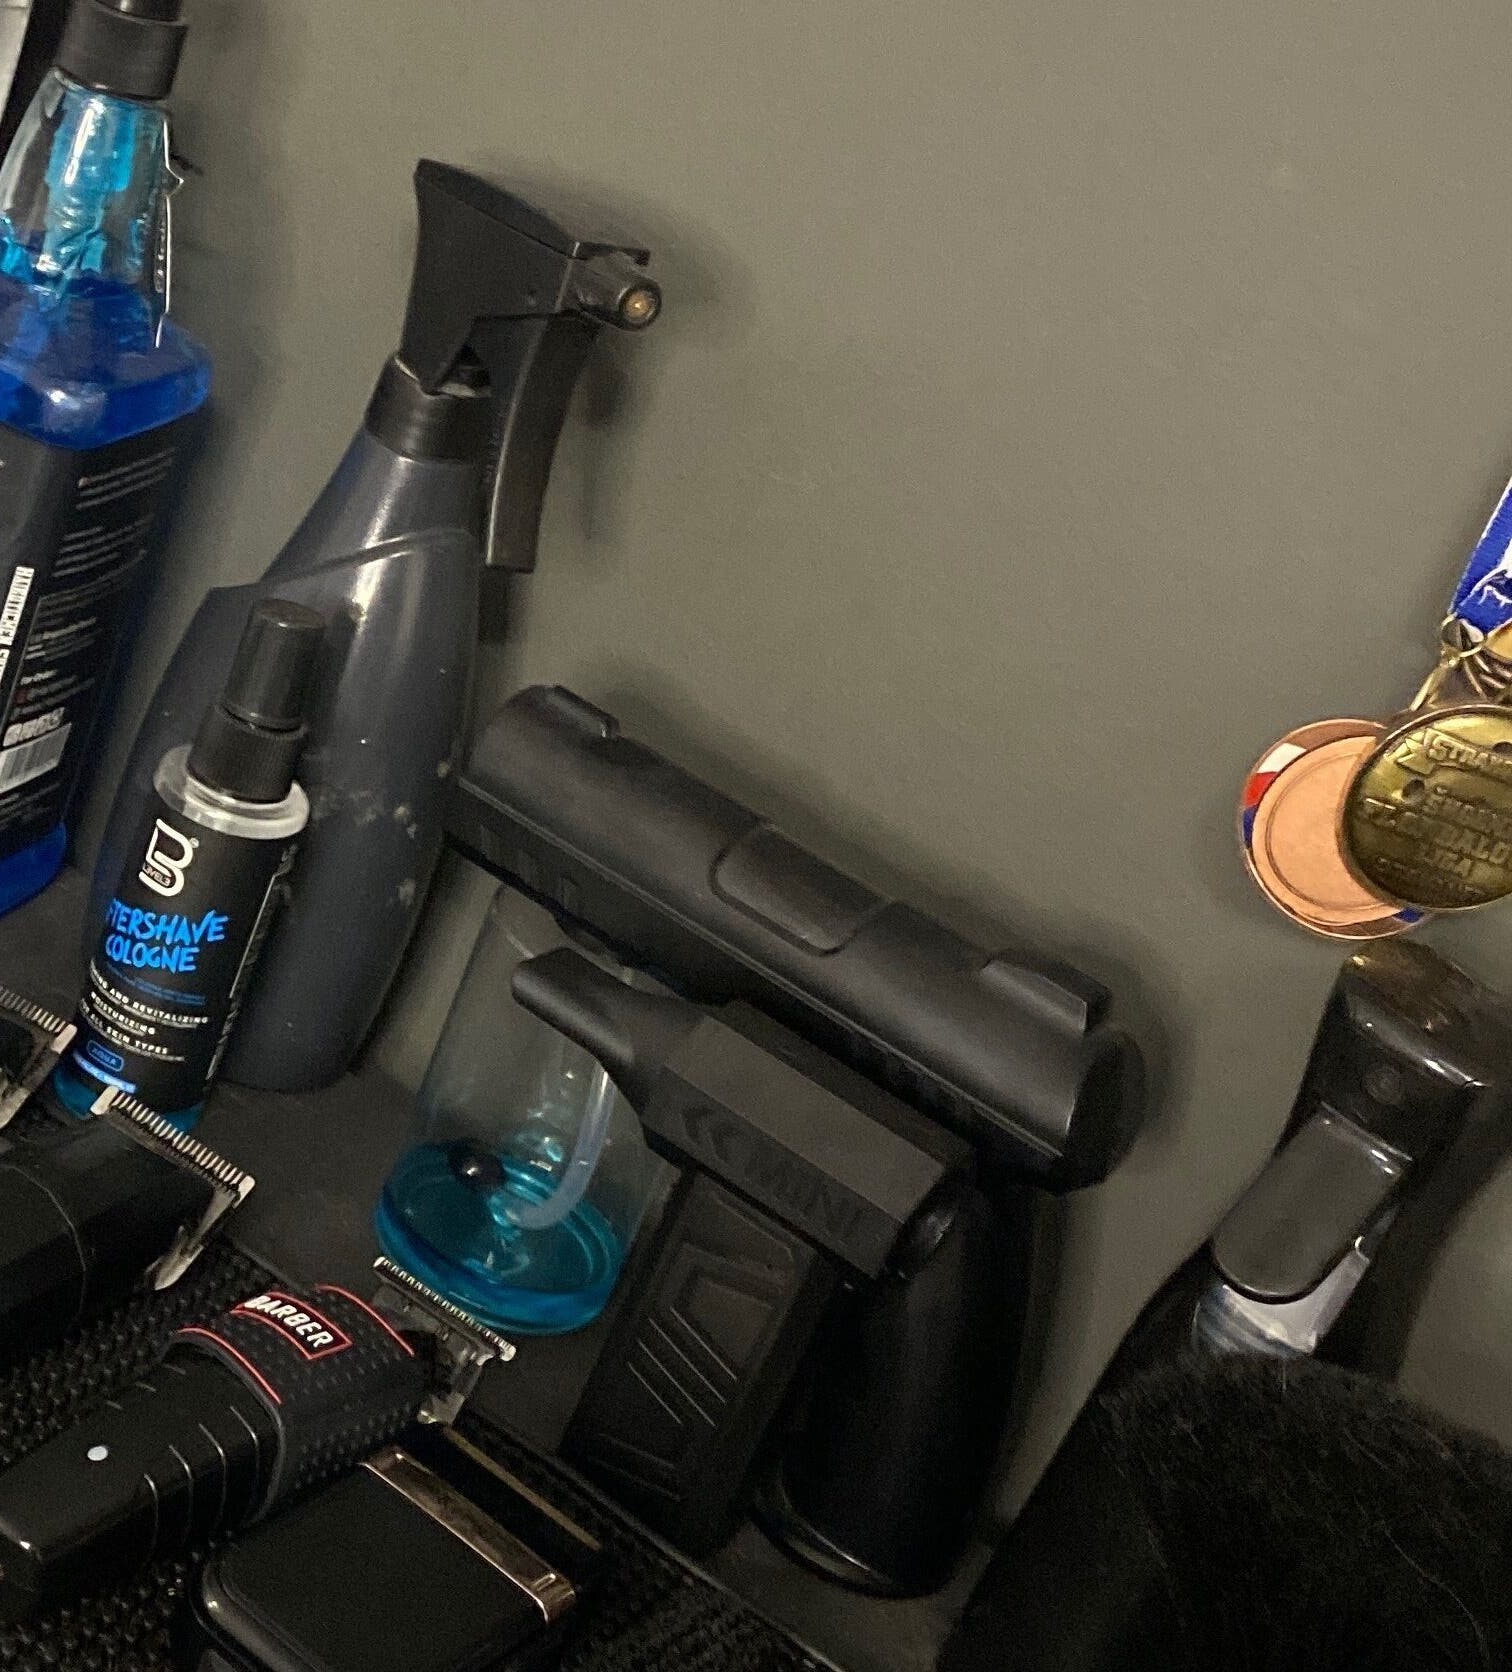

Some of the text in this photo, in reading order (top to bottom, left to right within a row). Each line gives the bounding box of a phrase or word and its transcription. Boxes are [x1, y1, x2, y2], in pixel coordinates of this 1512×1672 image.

[105, 934, 201, 974] COLOGNE
[109, 988, 208, 1024] AND REVITALIZING
[106, 1026, 130, 1043] SKIN
[135, 1040, 168, 1055] TYPES
[244, 1295, 334, 1348] BARBER
